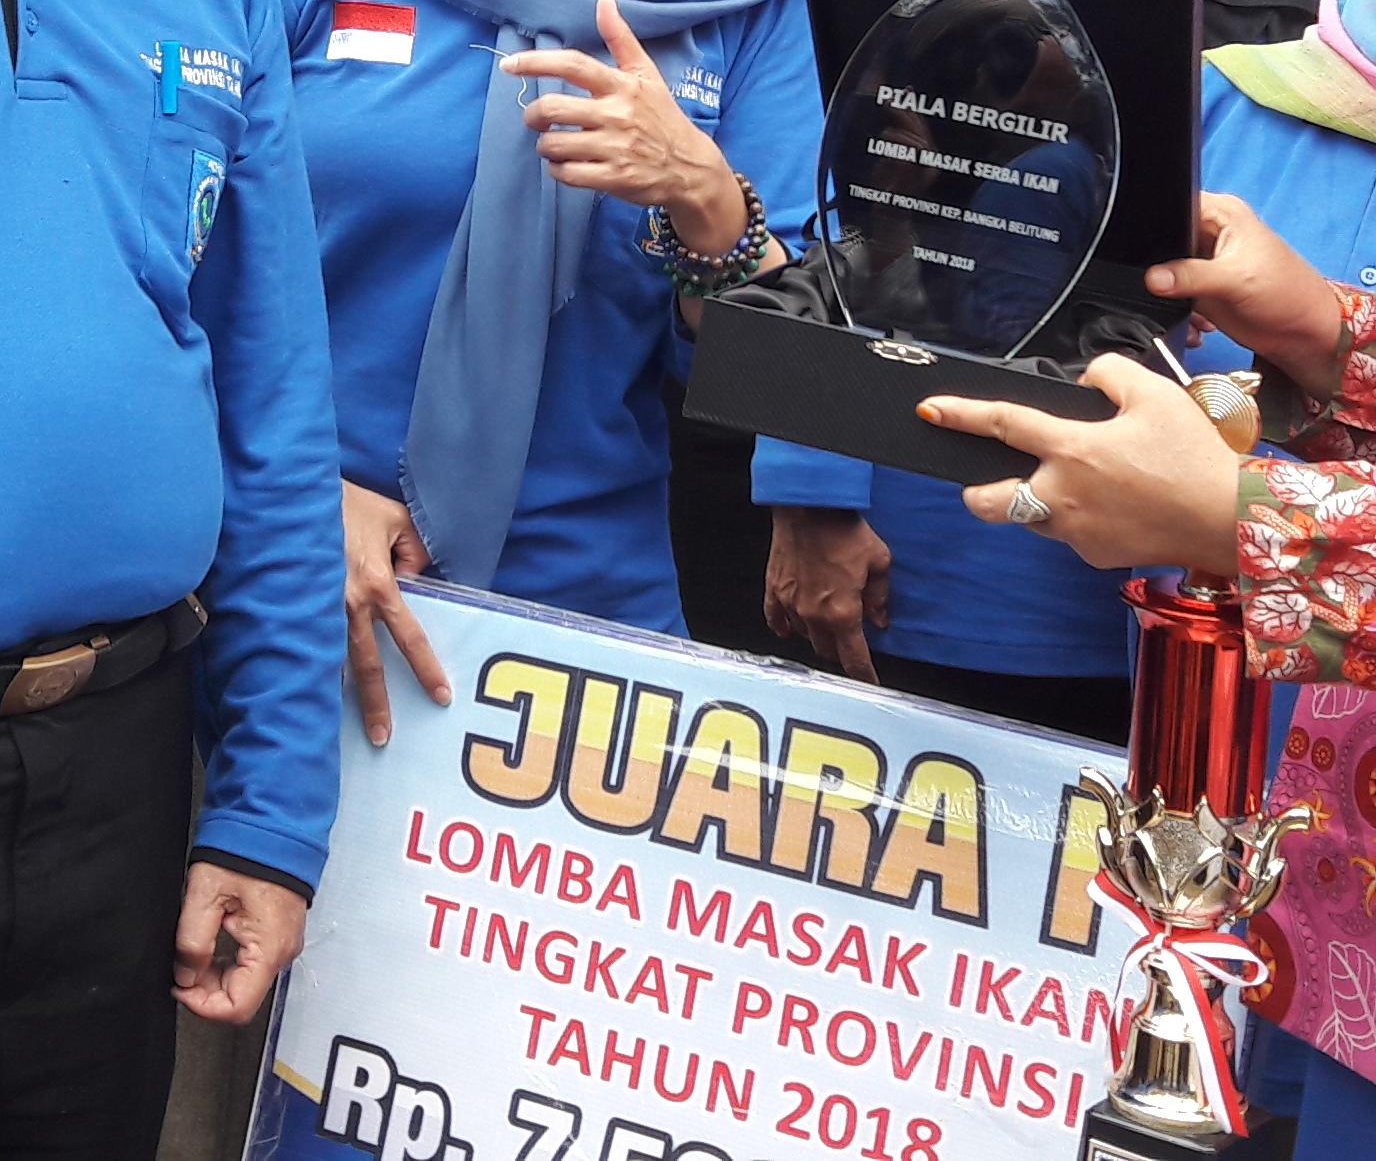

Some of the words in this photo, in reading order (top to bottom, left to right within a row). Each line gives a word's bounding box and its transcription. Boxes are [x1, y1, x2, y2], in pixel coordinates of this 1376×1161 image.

[867, 138, 917, 163] LOMBA
[919, 149, 972, 175] MASAK
[973, 161, 1021, 185] SERBA
[1022, 172, 1060, 194] IKAN
[876, 85, 946, 118] PIALA
[951, 101, 1069, 144] BERGILIR
[849, 184, 892, 206] TINGKAT
[892, 193, 940, 216] PROVINSI
[940, 204, 963, 221] KEP.
[963, 210, 1007, 232] BANGKA
[1008, 220, 1061, 243] BELITUNG
[912, 245, 949, 265] TAHUN
[949, 253, 975, 272] 2018
[461, 652, 988, 929] JUARA
[406, 810, 641, 921] LOMBA
[667, 879, 927, 997] MASAK
[949, 954, 1134, 1043] IKAN
[424, 895, 714, 1020] TINGKAT
[731, 981, 1084, 1129] PROVINSI
[520, 1005, 755, 1122] TAHUN
[776, 1082, 943, 1161] 2018
